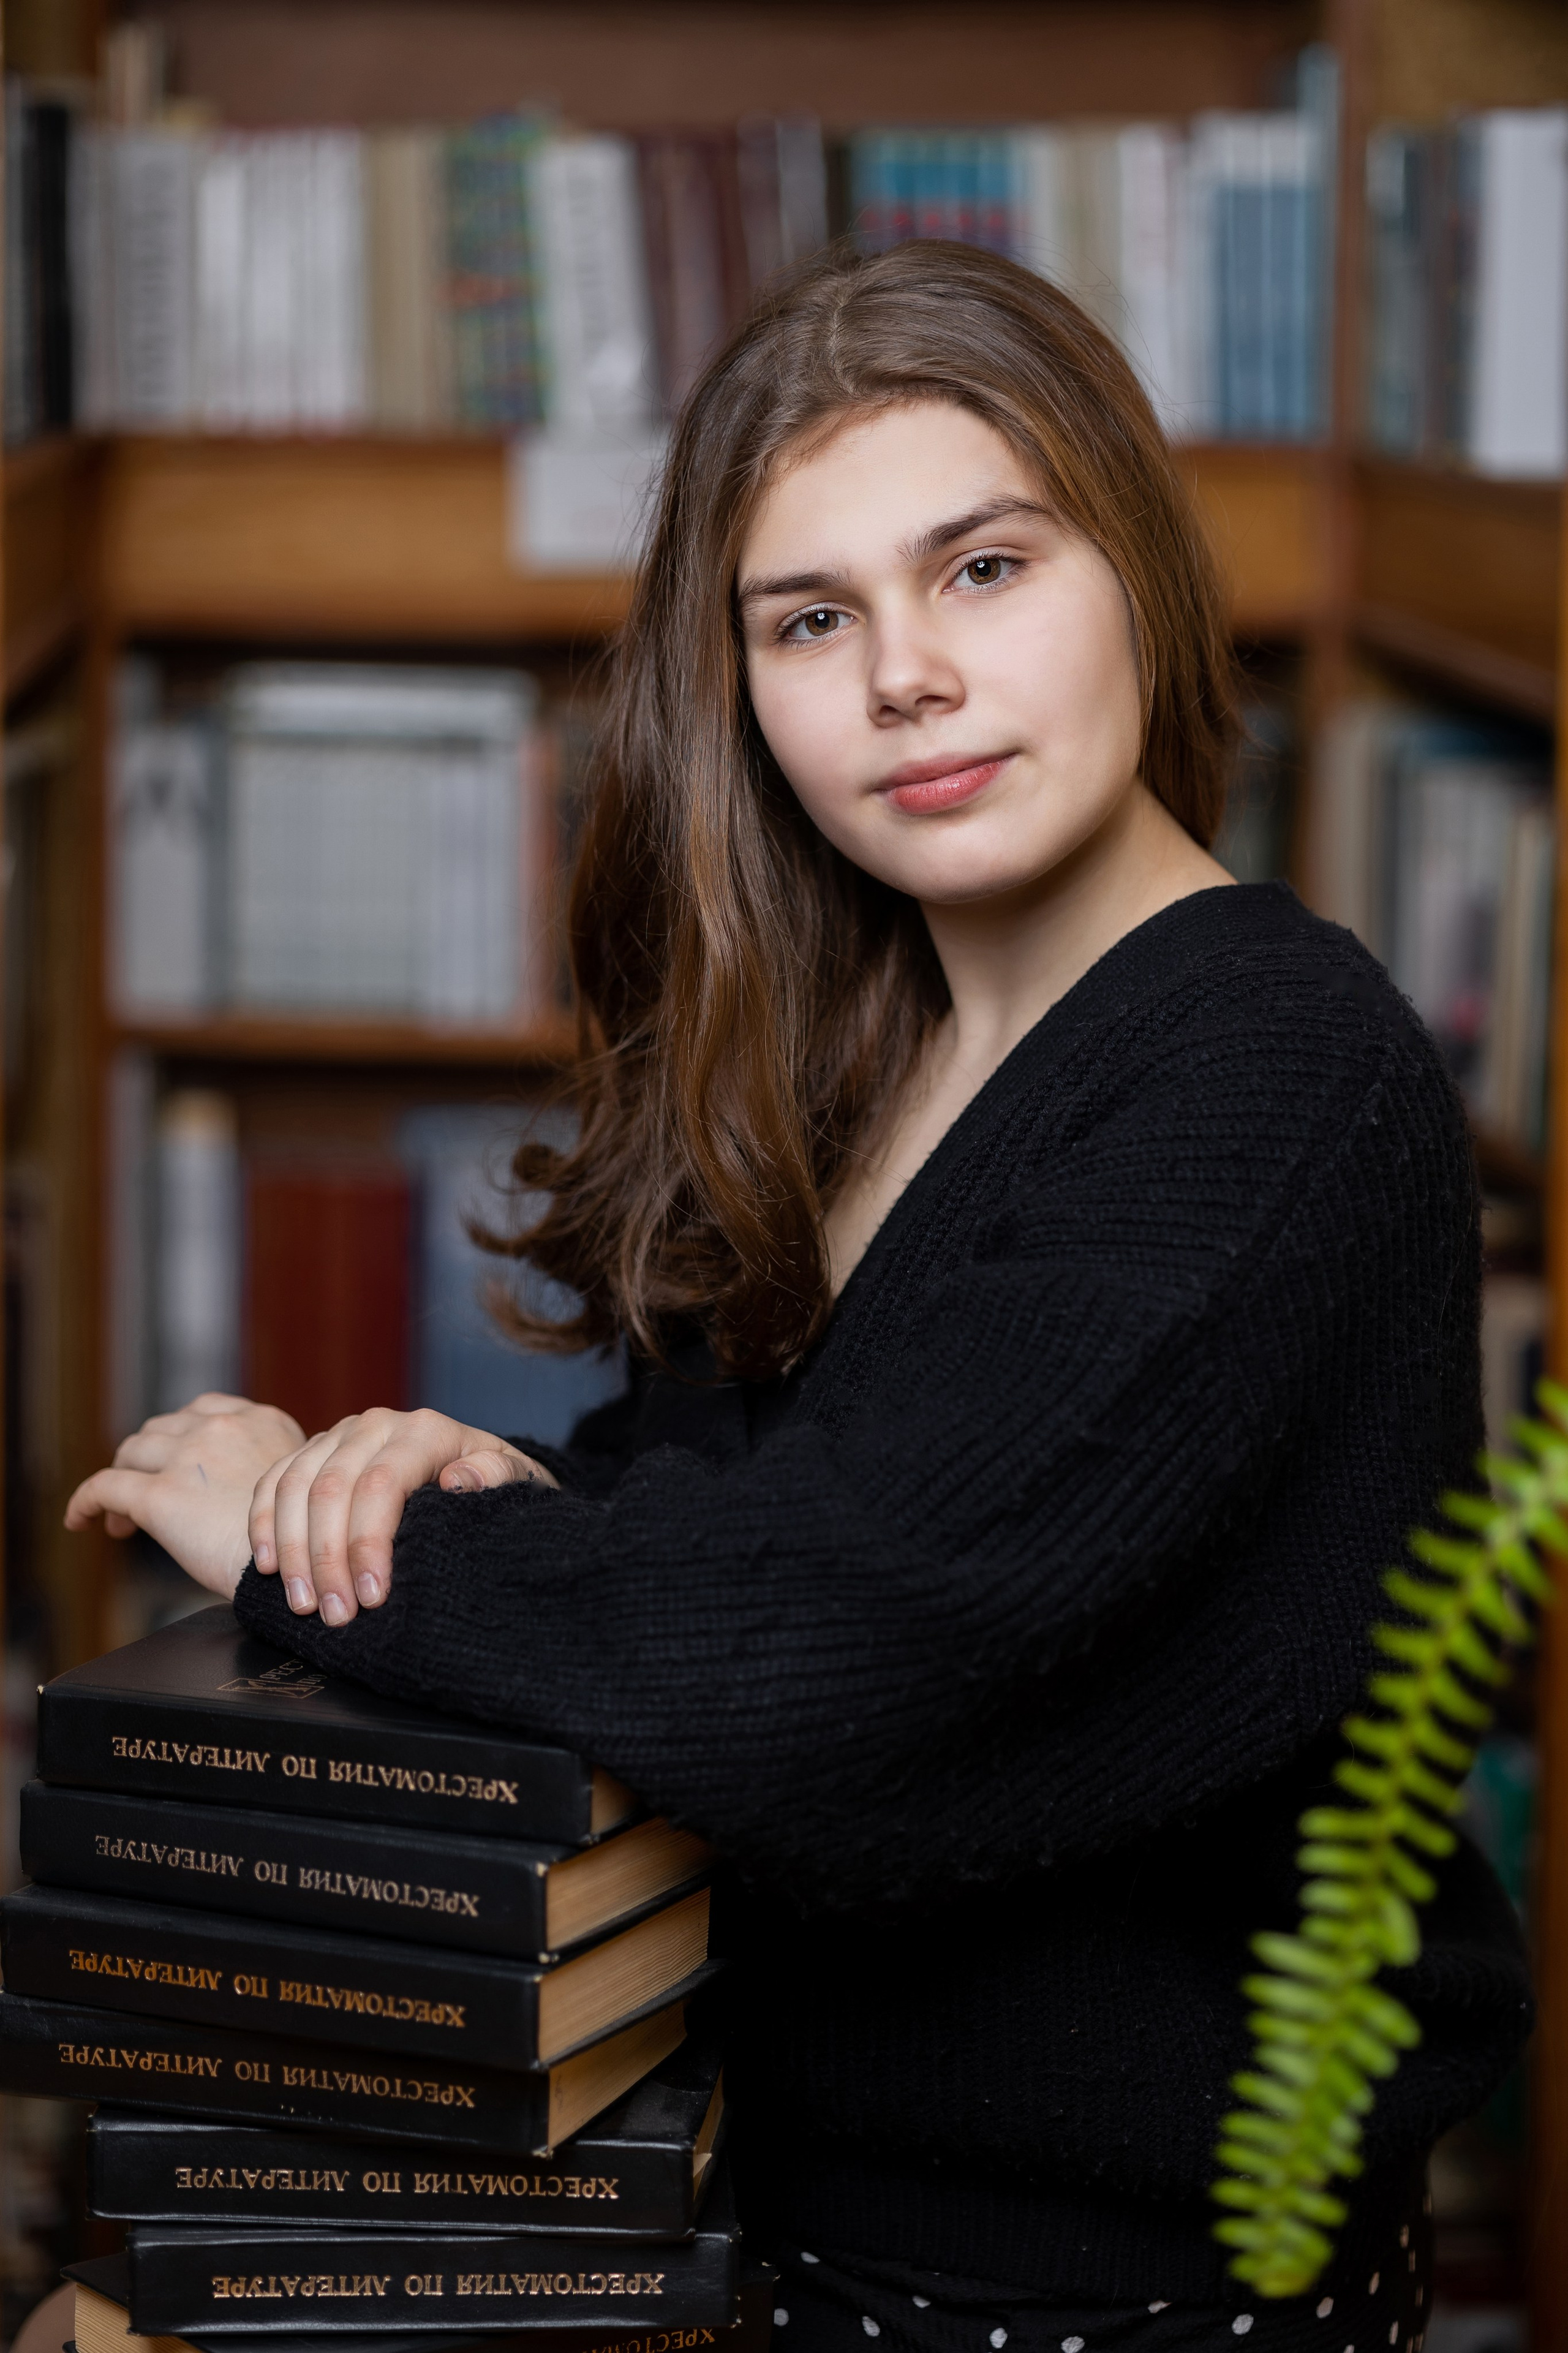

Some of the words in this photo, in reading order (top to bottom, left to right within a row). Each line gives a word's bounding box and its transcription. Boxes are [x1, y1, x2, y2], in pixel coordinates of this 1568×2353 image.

[112, 1737, 271, 1772] ЛИТЕРАТУРЕ
[282, 1755, 317, 1779] ПО
[328, 1760, 518, 1804] ХРЕСТОМАТИЯ
[96, 1835, 244, 1876] ЛИТЕРАТУРЕ
[254, 1861, 287, 1885] ПО
[299, 1867, 480, 1917] ХРЕСТОМАТИЯ
[69, 1949, 222, 1990] ЛИТЕРАТУРЕ
[233, 1974, 268, 1998] ПО
[279, 1980, 466, 2028] ХРЕСТОМАТИЯ
[59, 2044, 222, 2077] ЛИТЕРАТУРЕ
[235, 2061, 270, 2083] ПО
[282, 2066, 475, 2109] ХРЕСТОМАТИЯ
[175, 2167, 350, 2191] ЛИТЕРАТУРЕ
[363, 2171, 401, 2193] ПО
[414, 2173, 619, 2199] ХРЕСТОМАТИЯ
[212, 2276, 391, 2298] ЛИТЕРАТУРЕ
[405, 2275, 444, 2296] ПО
[456, 2273, 665, 2295] ХРЕСТОМАТИЯ
